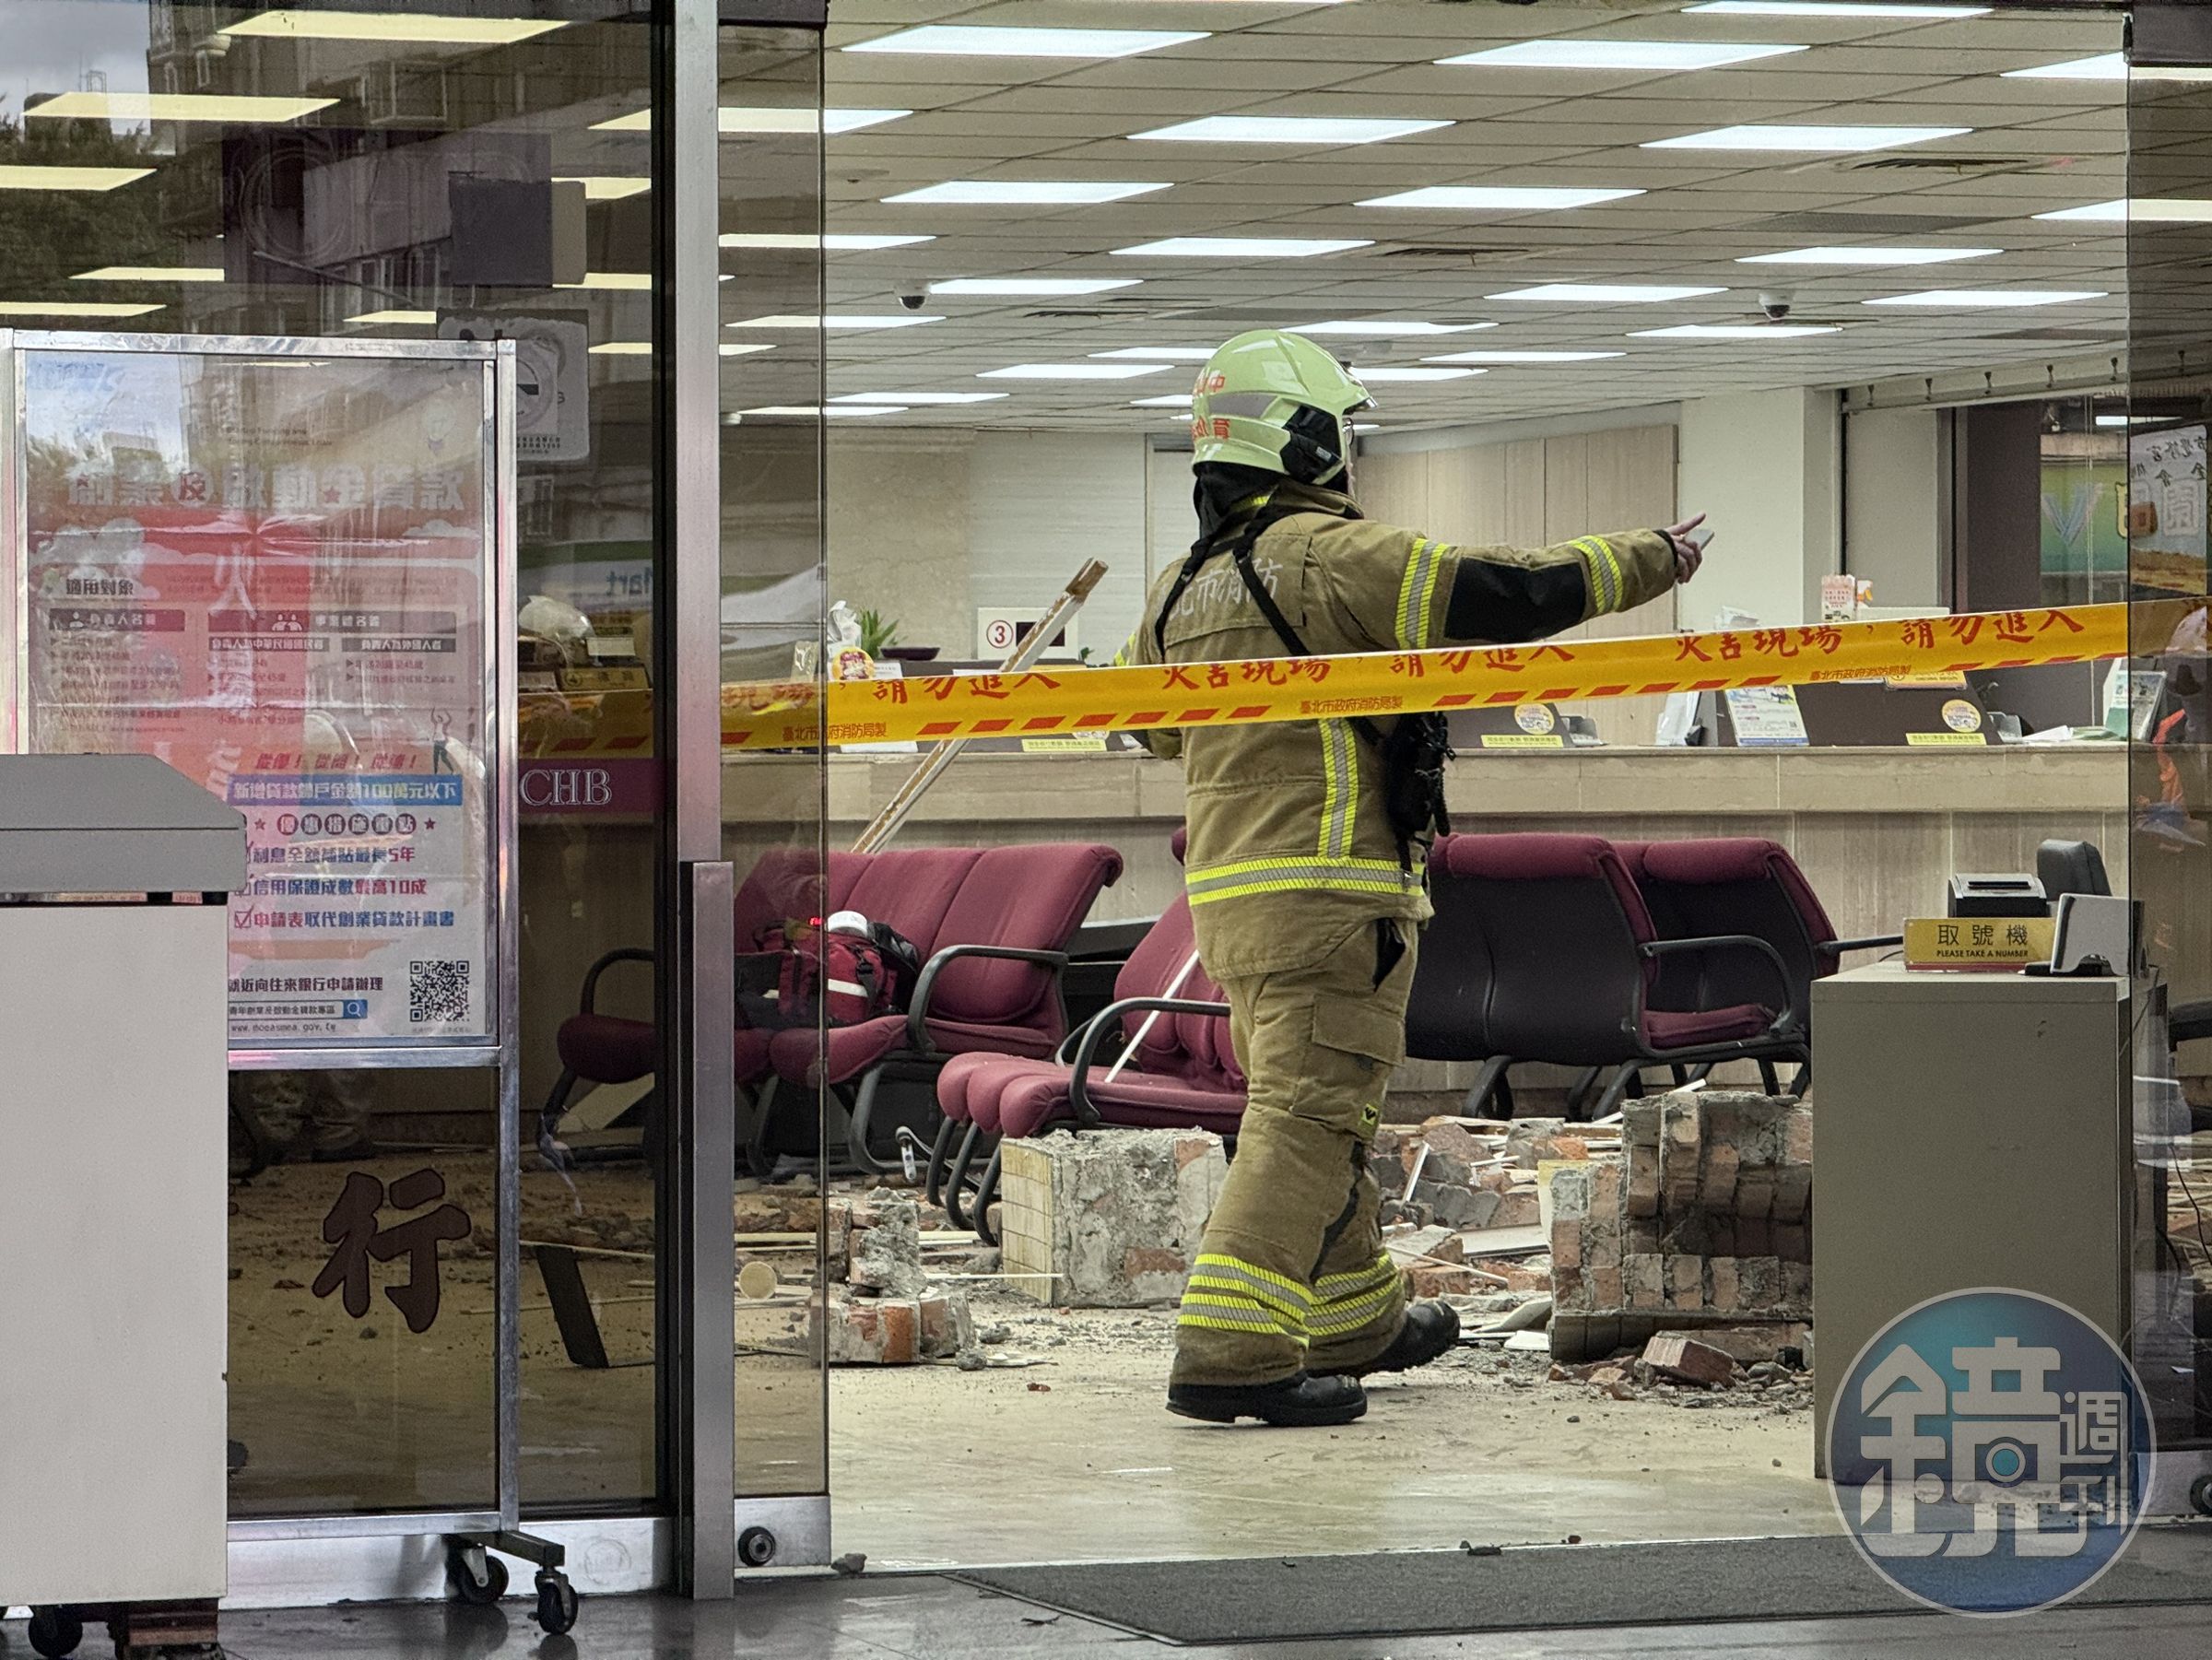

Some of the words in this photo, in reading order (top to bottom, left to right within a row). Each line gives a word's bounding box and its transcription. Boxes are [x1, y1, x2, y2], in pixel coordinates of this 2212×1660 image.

[782, 722, 887, 742] 臺北市府消防局製
[520, 768, 613, 806] CHB
[253, 878, 427, 896] 信用保證成數最高10成
[253, 910, 454, 927] 申請表取代創業貸款計畫書
[1937, 924, 2028, 947] 取號機
[1936, 949, 1964, 958] PLEASE
[1966, 949, 1985, 958] TAKE
[1986, 949, 1994, 958] A
[1995, 949, 2029, 958] NUMBER
[312, 1168, 472, 1334] 行
